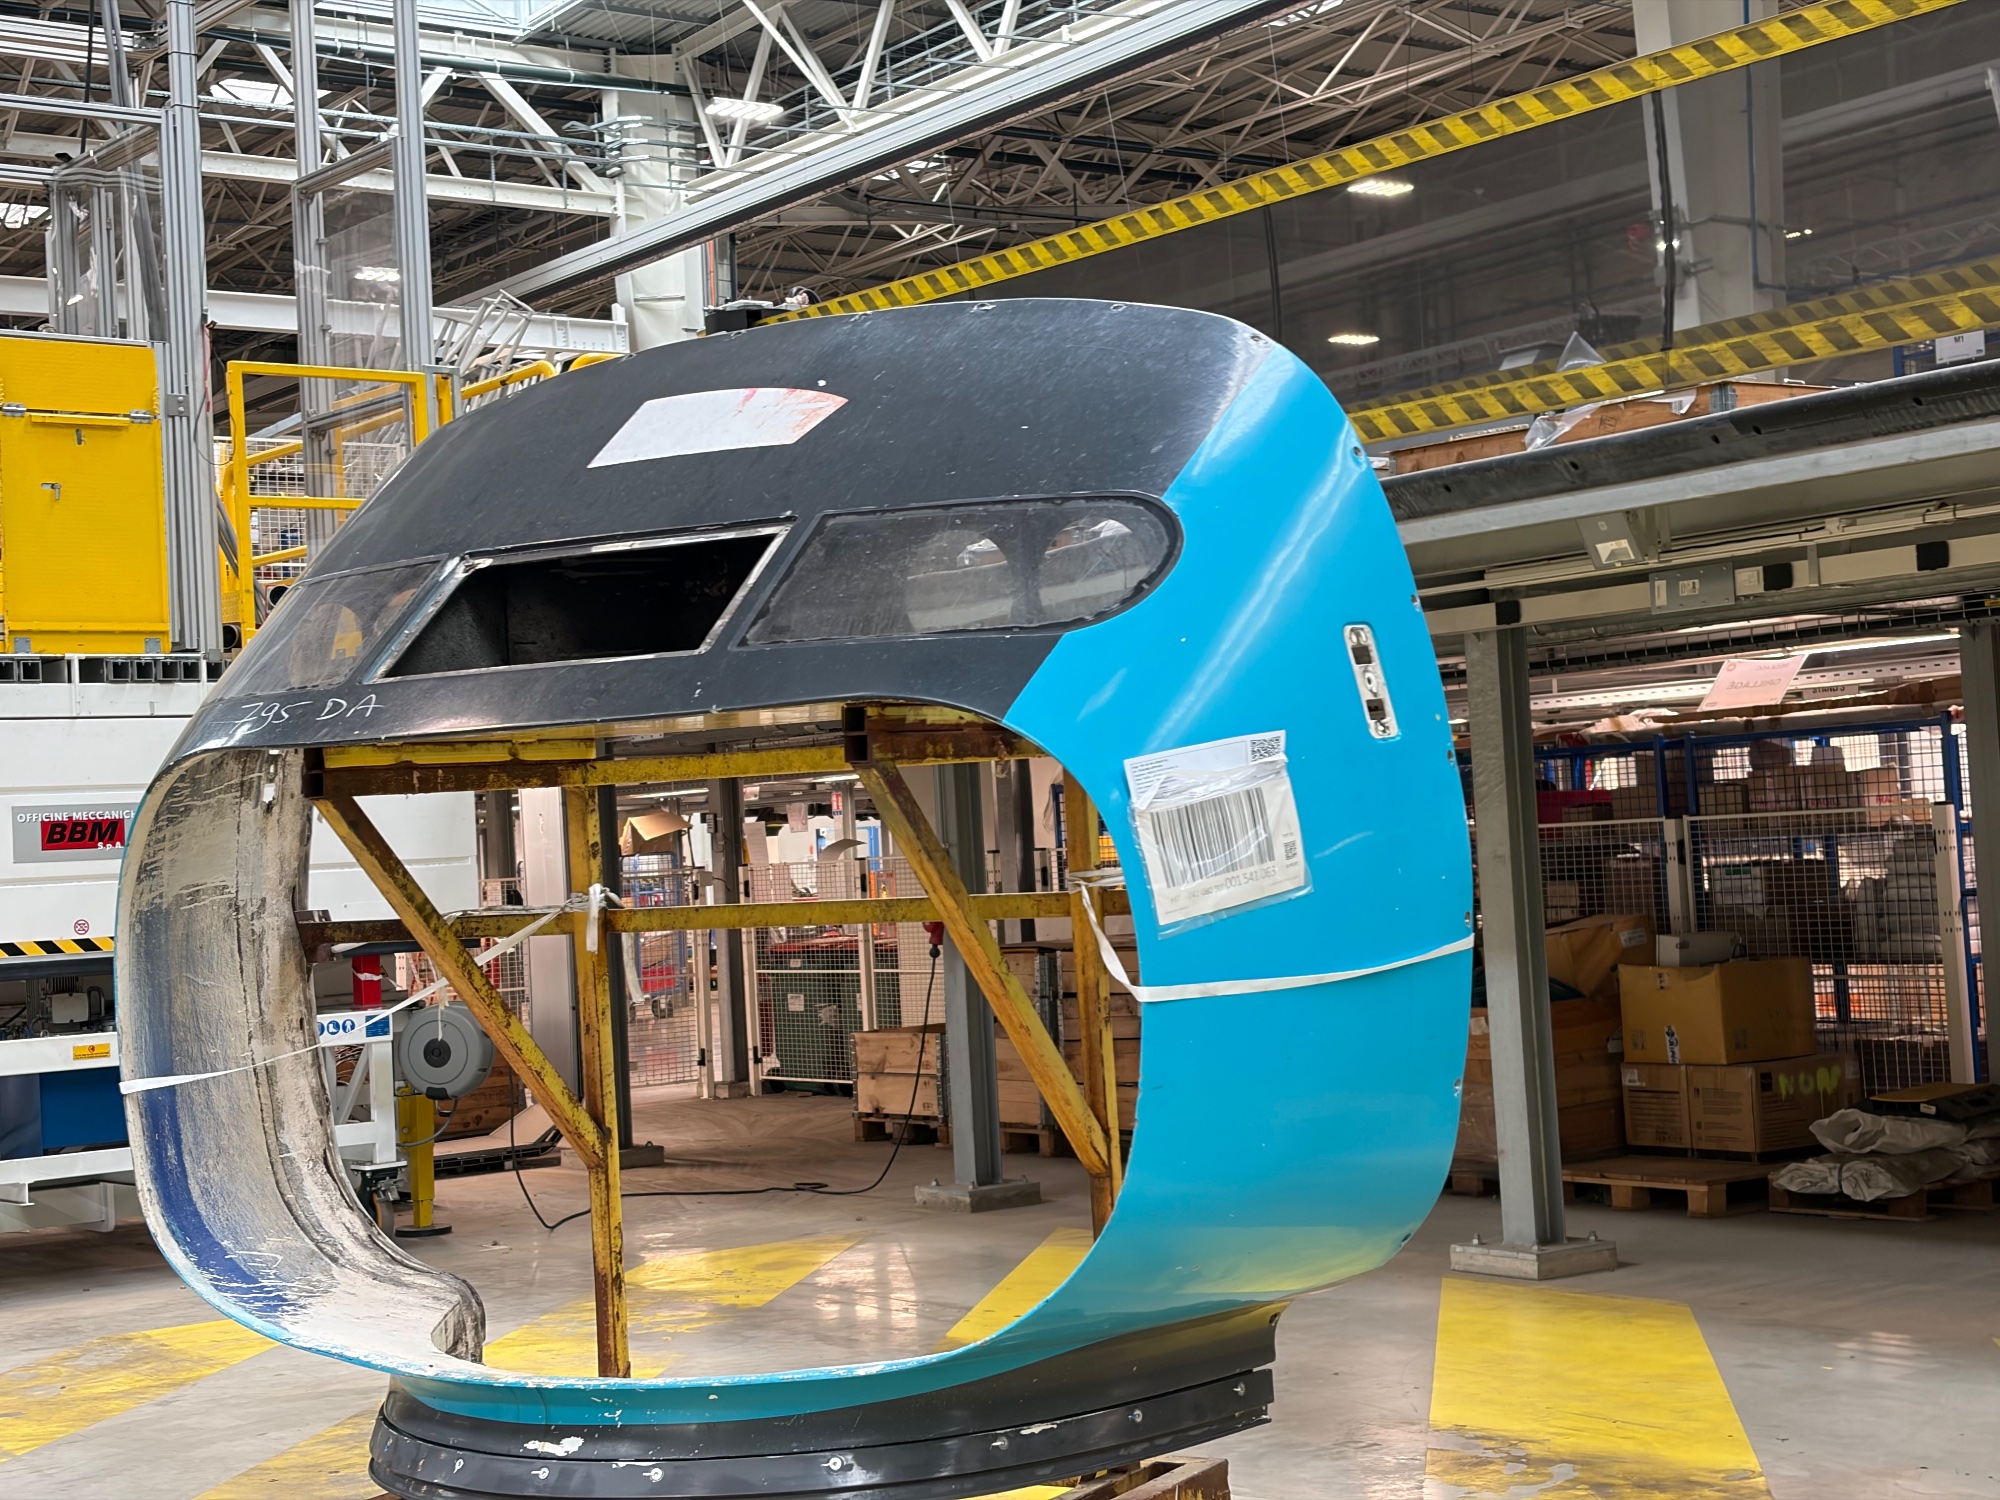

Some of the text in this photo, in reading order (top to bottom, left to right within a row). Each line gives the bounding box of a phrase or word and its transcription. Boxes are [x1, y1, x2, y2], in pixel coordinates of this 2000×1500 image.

[228, 694, 385, 735] 795 DA
[17, 812, 69, 823] OFFICINE
[46, 821, 120, 844] BBM
[97, 841, 124, 850] S.p.A.
